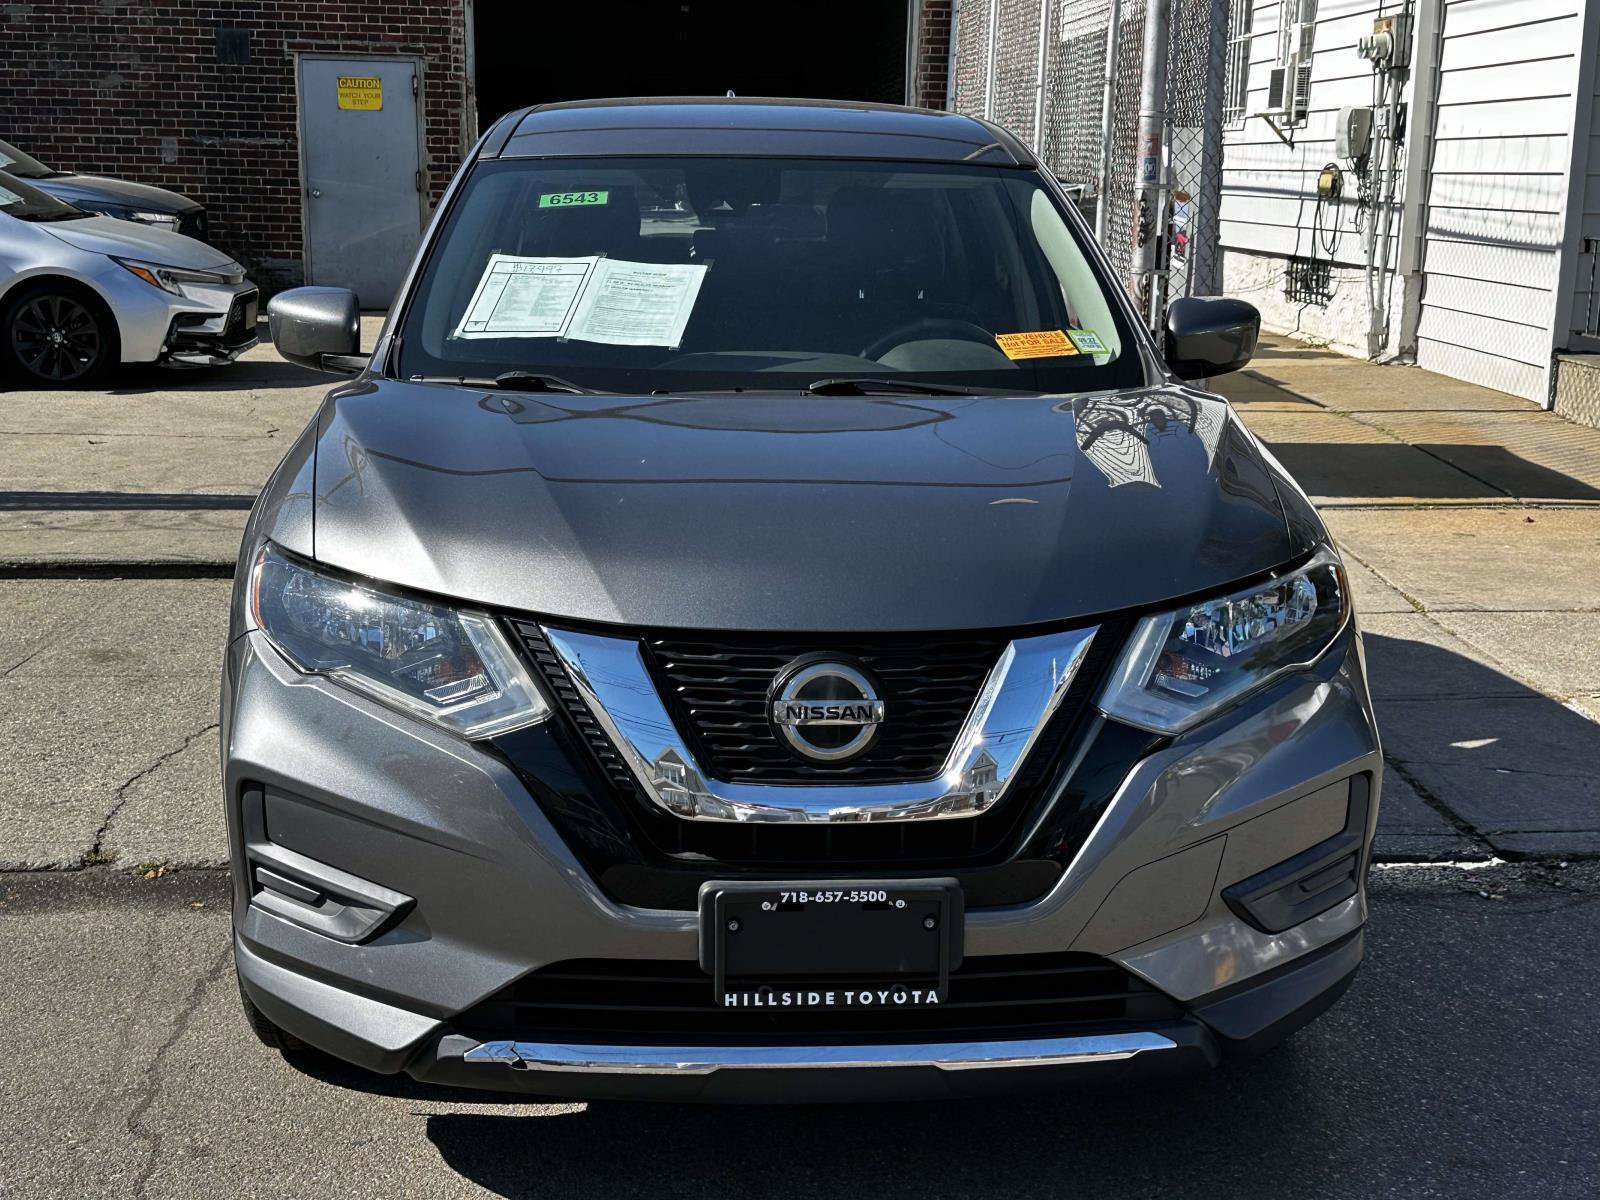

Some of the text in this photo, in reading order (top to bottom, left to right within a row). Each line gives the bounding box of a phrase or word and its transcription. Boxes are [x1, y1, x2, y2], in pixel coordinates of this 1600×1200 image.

[339, 79, 380, 88] CAUTION
[549, 192, 599, 205] 6543
[997, 331, 1061, 342] THIS VEHICLE
[1043, 337, 1067, 345] SALE
[786, 705, 873, 721] NISSAN
[780, 890, 887, 903] 718-657-5500
[725, 990, 939, 1007] HILLSIDE TOYOTA
